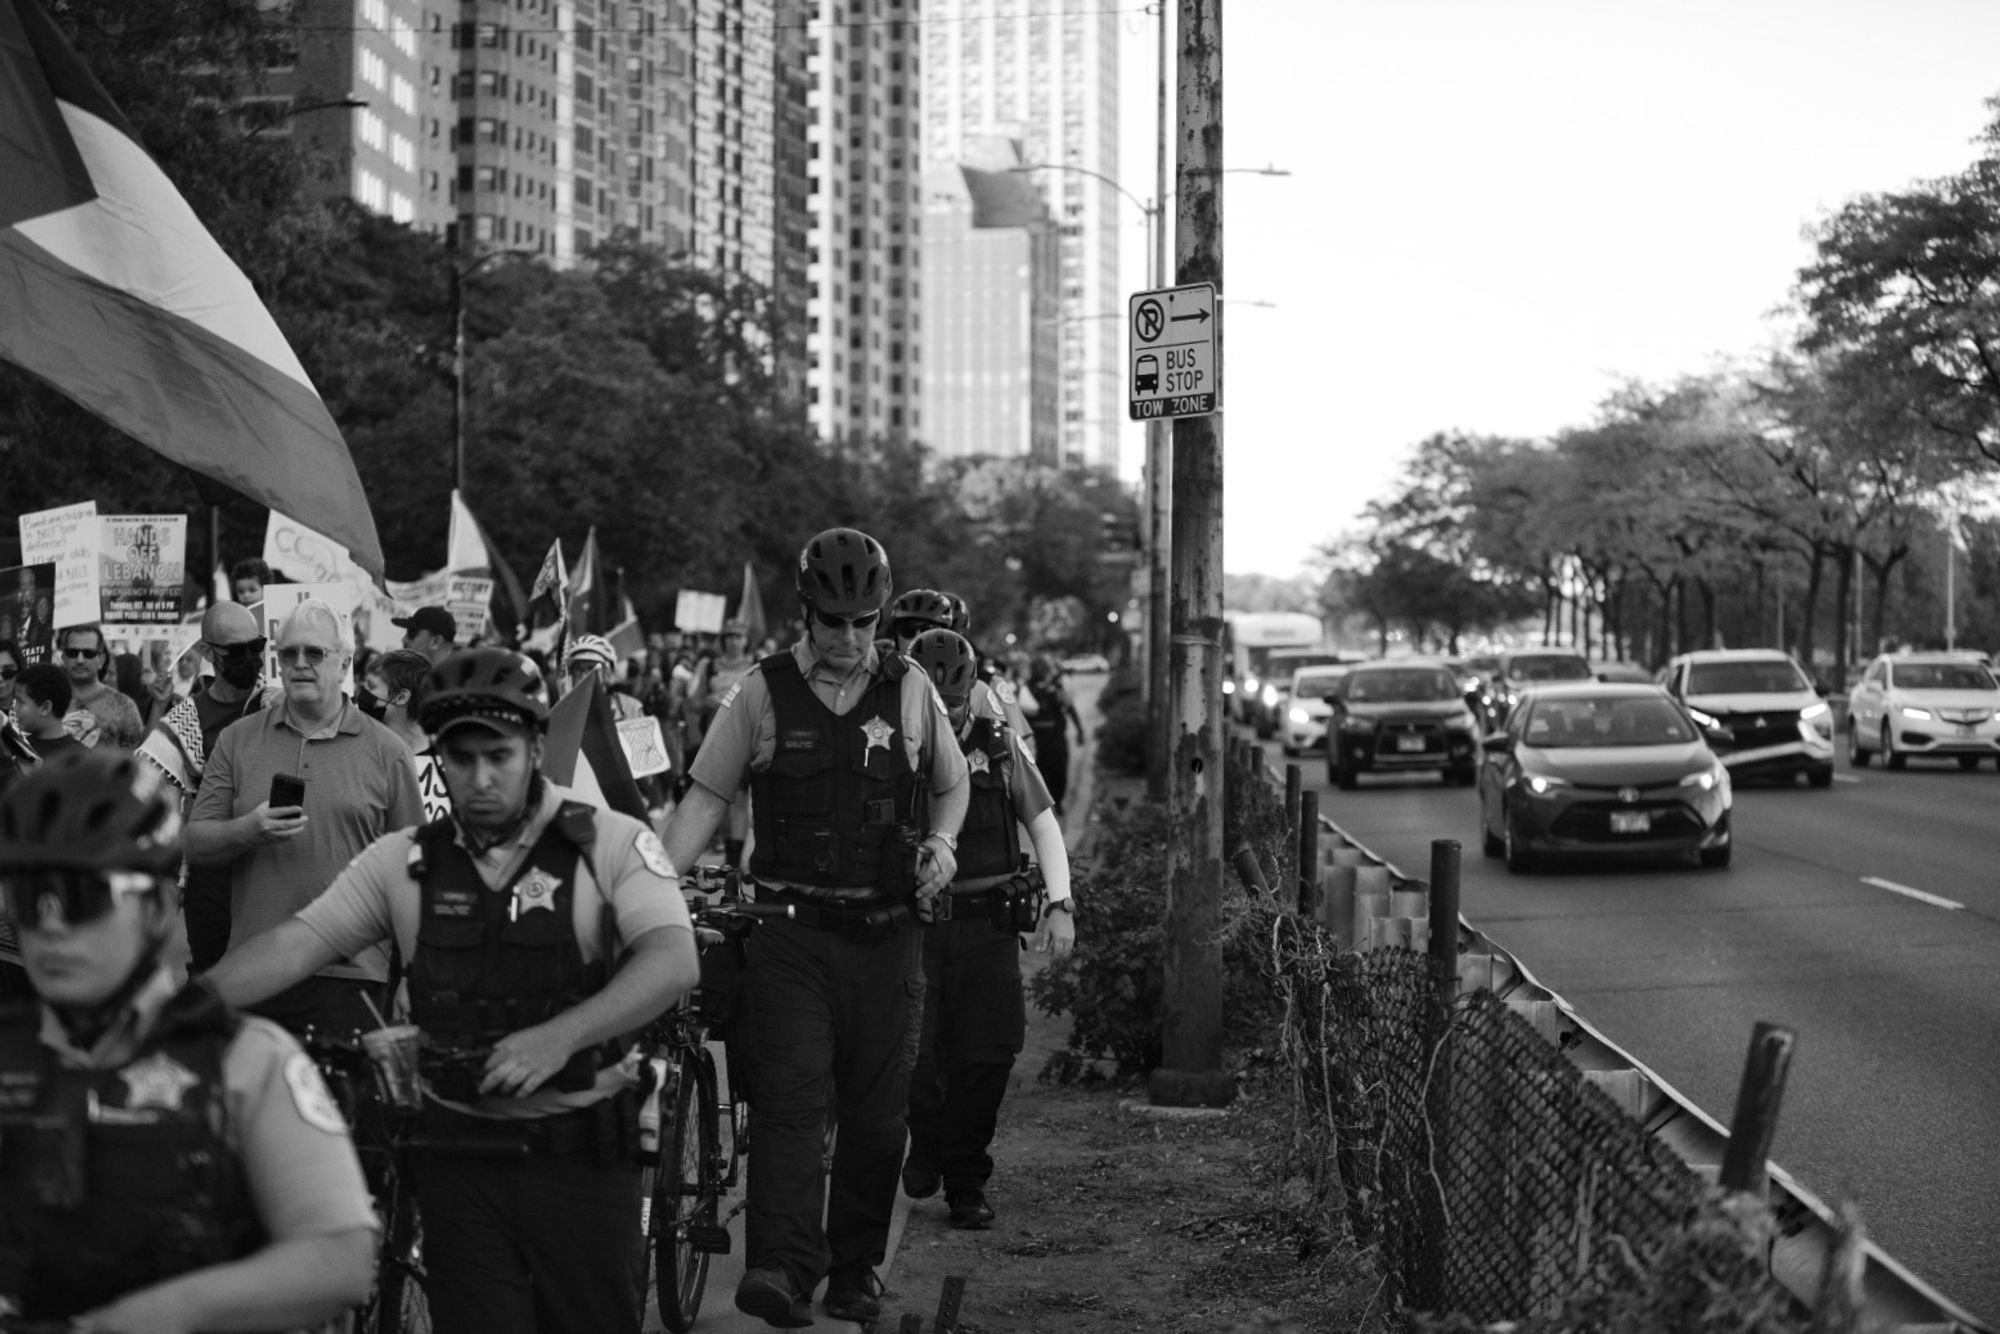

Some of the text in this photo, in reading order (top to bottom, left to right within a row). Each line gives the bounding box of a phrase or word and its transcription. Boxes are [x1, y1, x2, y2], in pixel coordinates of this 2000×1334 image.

[1166, 348, 1196, 370] BUS
[1166, 370, 1203, 392] STOP
[1134, 395, 1208, 418] TOW ZONE
[113, 527, 170, 546] HANDS
[127, 545, 160, 562] OFF
[104, 562, 180, 581] LEBANON
